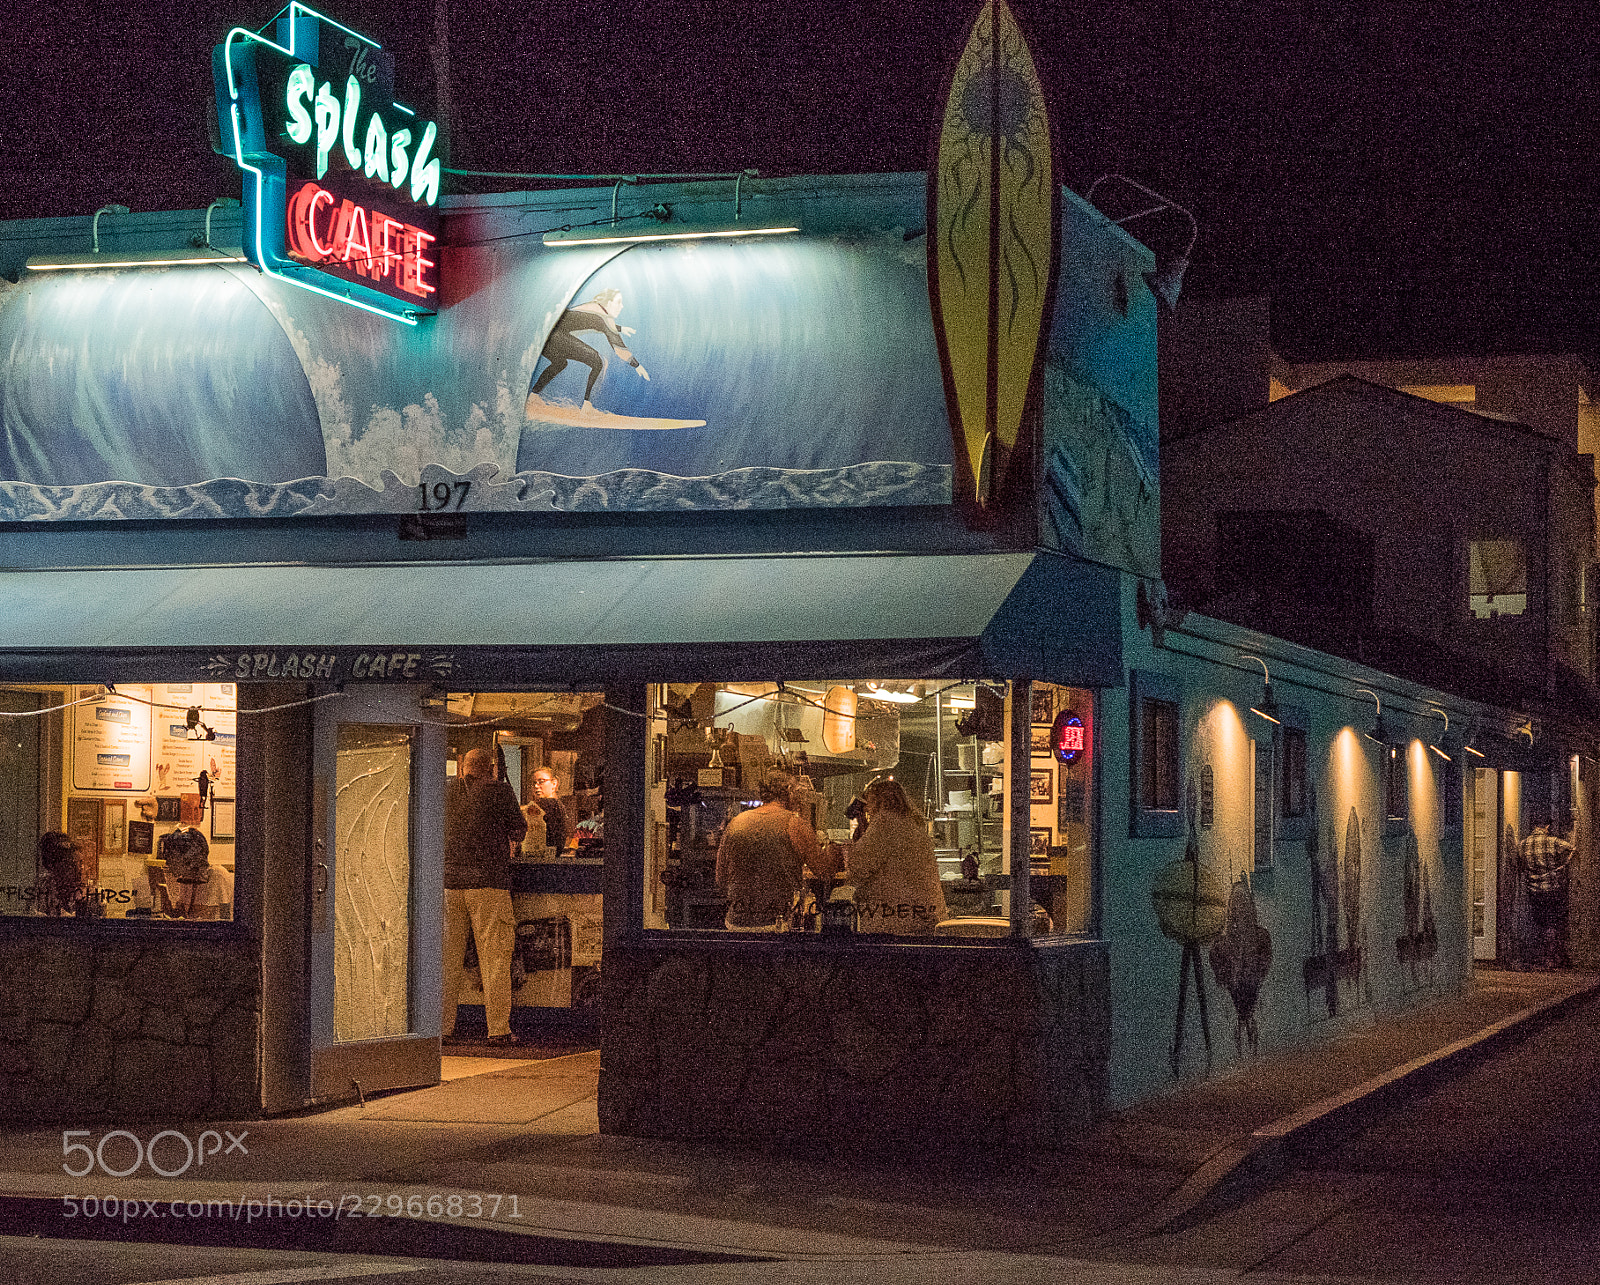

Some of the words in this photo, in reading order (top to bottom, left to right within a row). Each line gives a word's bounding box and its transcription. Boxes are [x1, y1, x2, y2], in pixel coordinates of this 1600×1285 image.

[344, 36, 378, 84] The
[289, 182, 436, 298] CAFE
[418, 481, 472, 511] 197
[235, 653, 337, 678] SPLASH
[352, 653, 421, 678] CAFE
